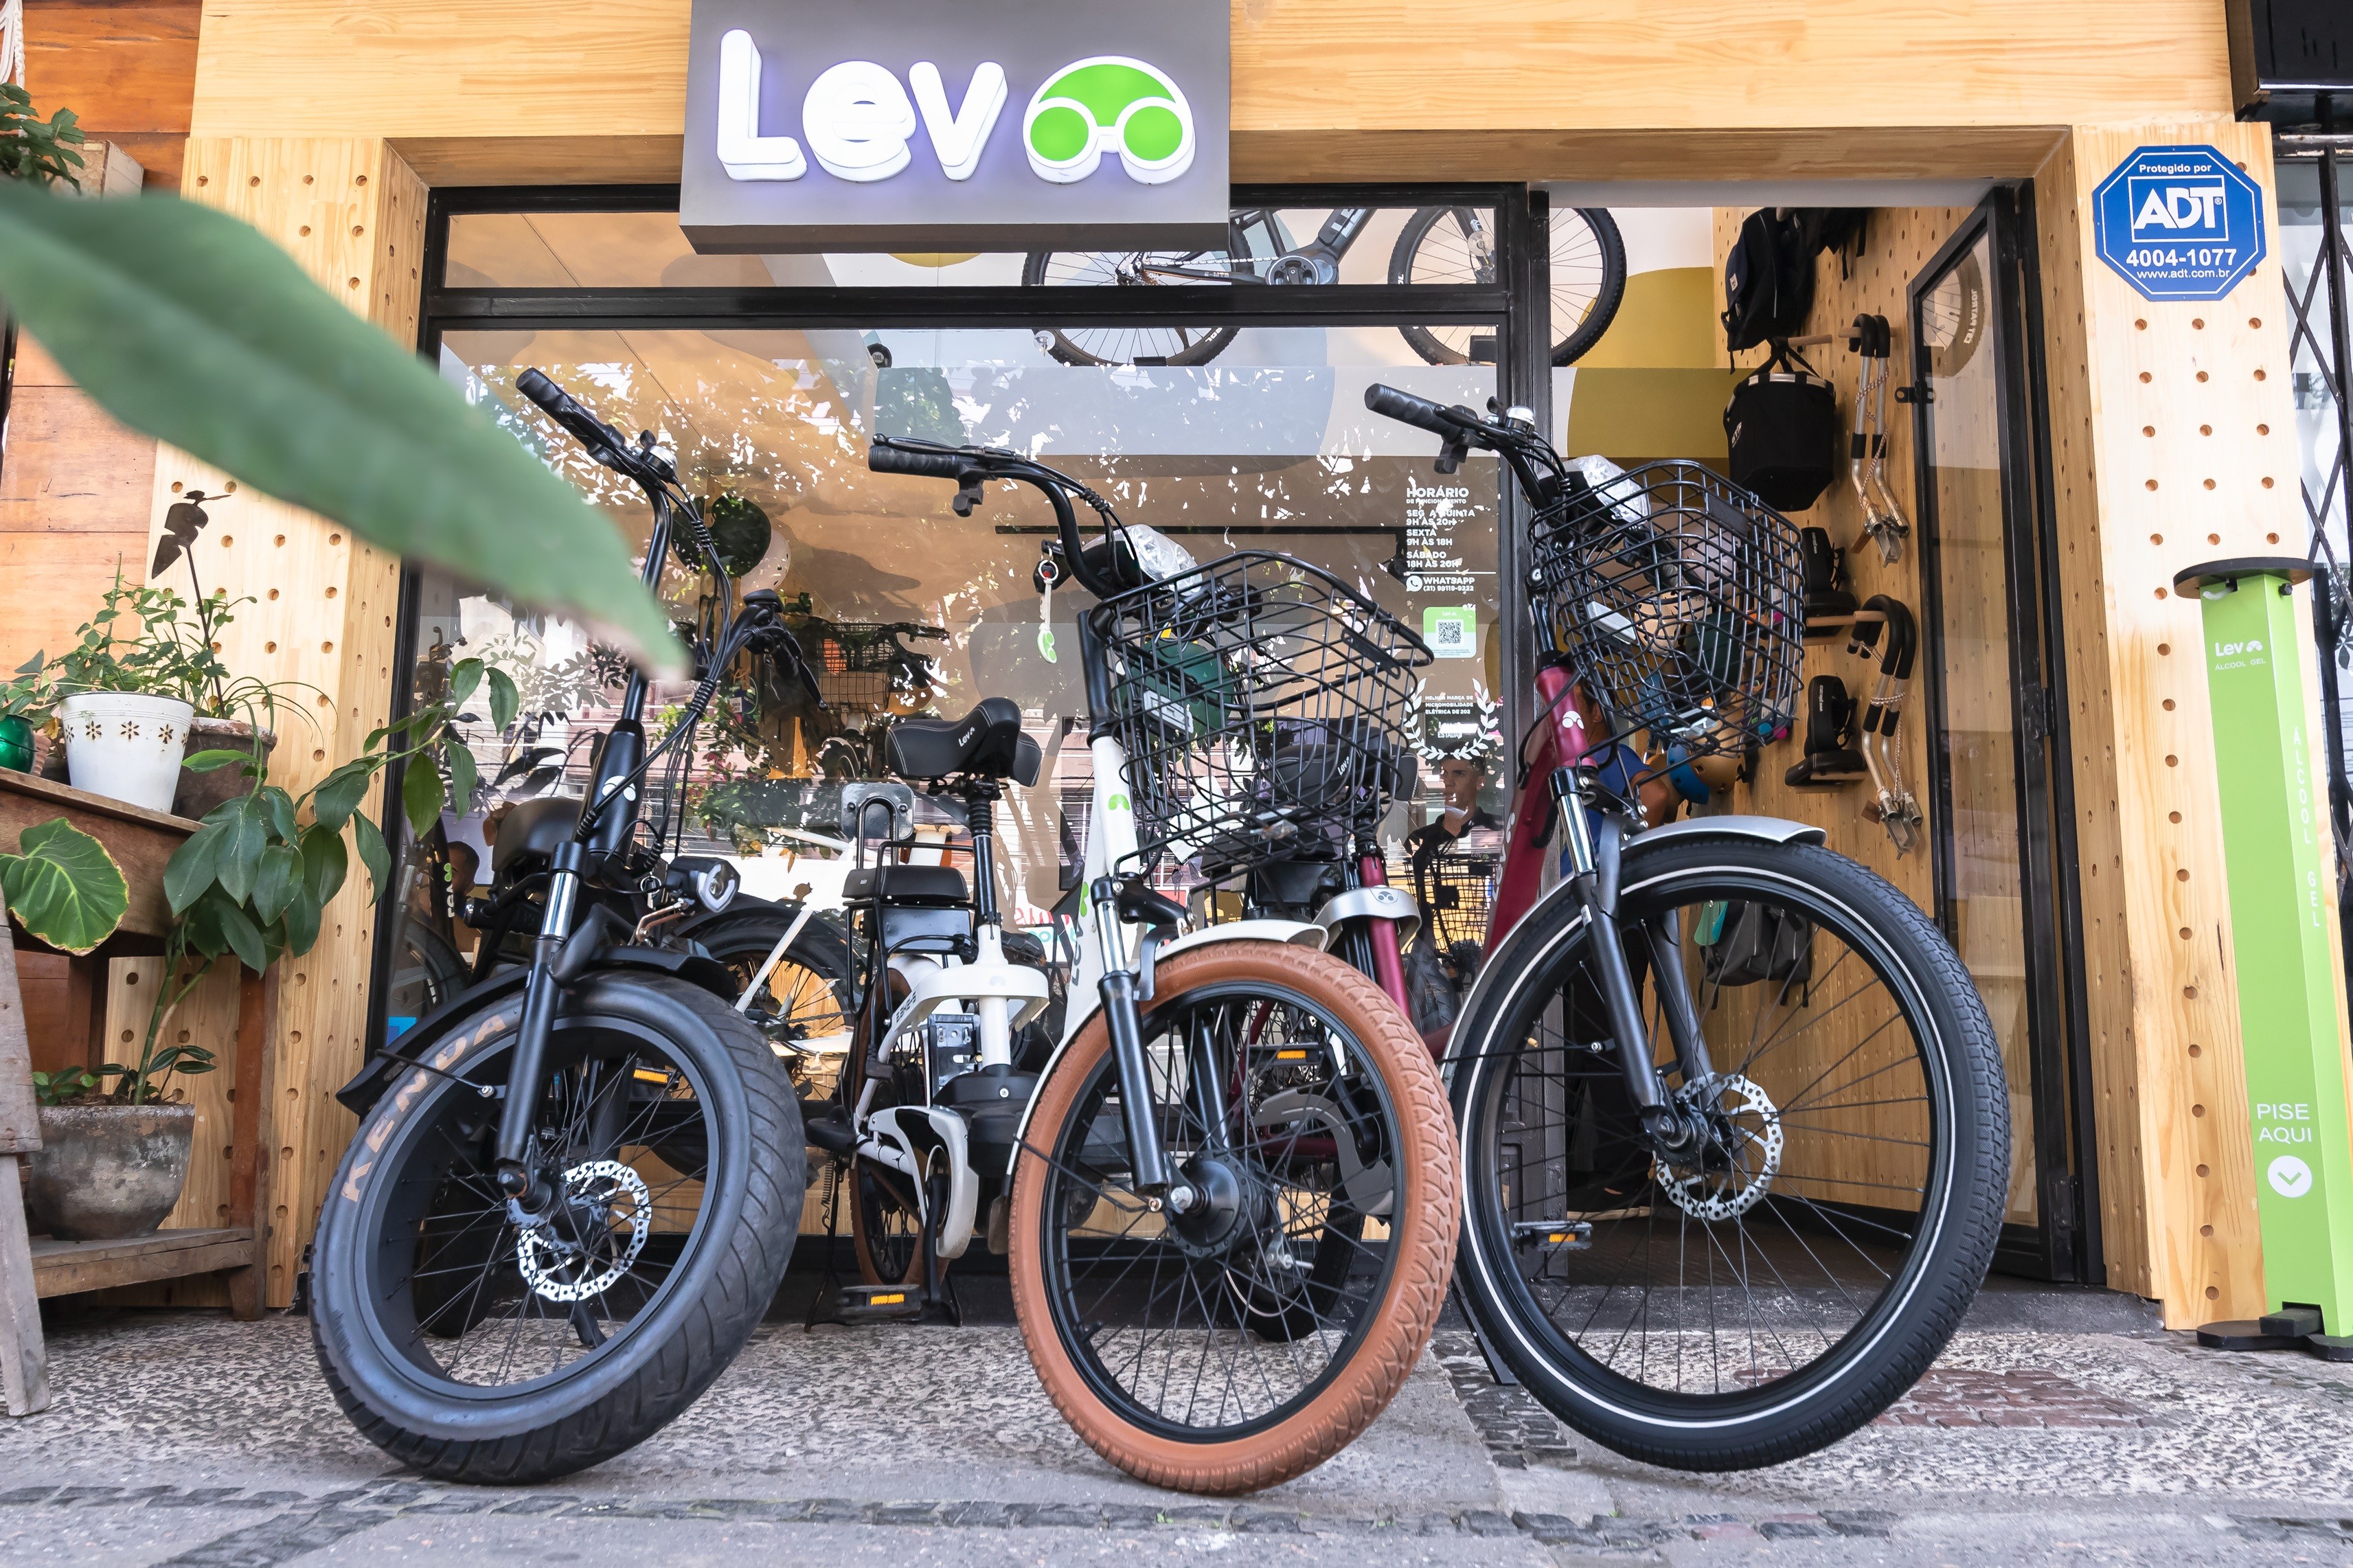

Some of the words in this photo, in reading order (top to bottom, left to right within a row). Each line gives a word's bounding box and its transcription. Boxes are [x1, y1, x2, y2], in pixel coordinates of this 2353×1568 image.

[718, 29, 1008, 183] Lev
[2139, 163, 2191, 174] Protegido
[2194, 165, 2212, 174] por
[2133, 187, 2223, 229] ADT
[2126, 249, 2237, 266] 4004-1077
[2137, 269, 2230, 279] www.adt.com.br
[1406, 485, 1469, 497] HORÁRIO
[1406, 528, 1437, 536] SEXTA
[1407, 549, 1446, 558] SÁBADO
[2215, 641, 2244, 657] Lev
[2250, 657, 2266, 666] GEL
[958, 731, 970, 747] Lev
[1337, 760, 1348, 775] Lev
[2293, 726, 2311, 844] ÁLCOOL
[2308, 870, 2320, 927] GEL
[341, 1015, 507, 1203] KENDA
[2257, 1103, 2310, 1120] PISE
[2258, 1127, 2312, 1144] AQUI
